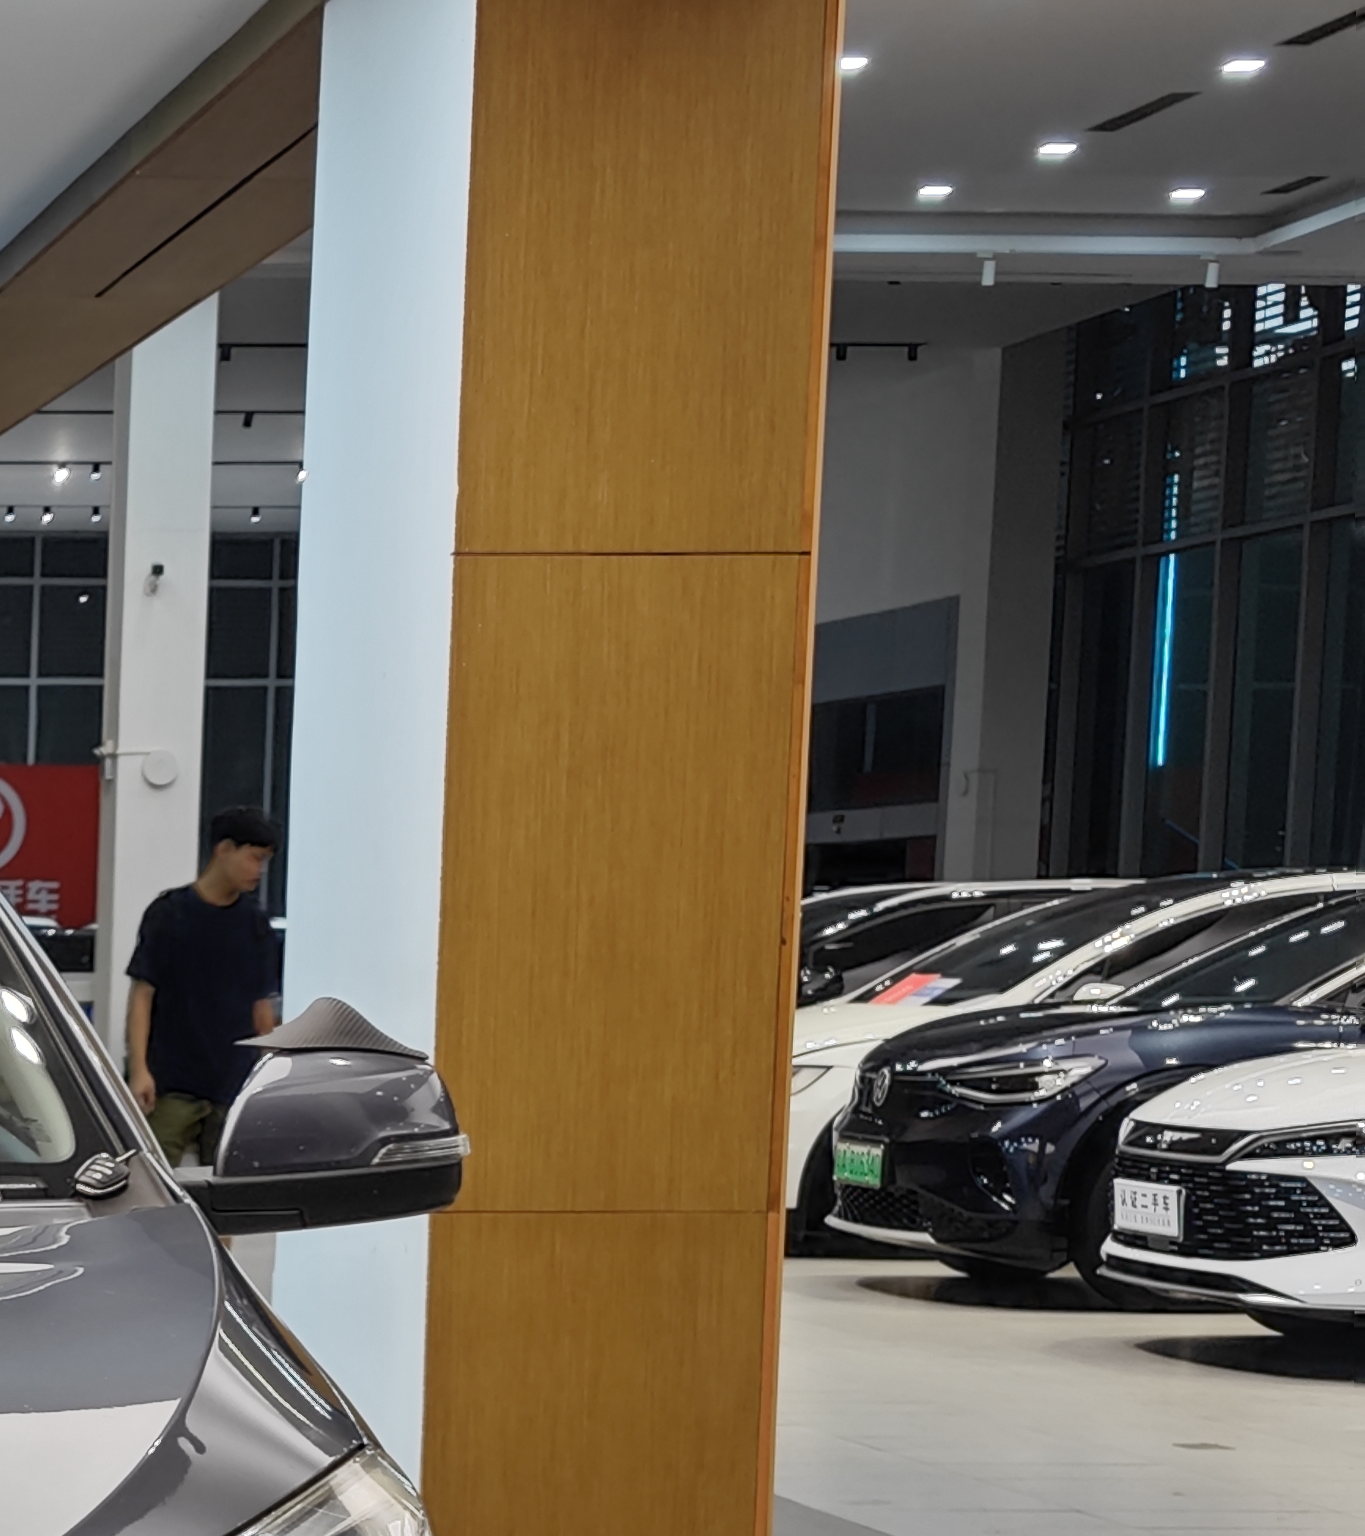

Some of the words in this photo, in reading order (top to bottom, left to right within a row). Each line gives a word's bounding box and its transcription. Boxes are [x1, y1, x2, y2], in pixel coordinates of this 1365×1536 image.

[1119, 1188, 1171, 1214] 认证二手车
